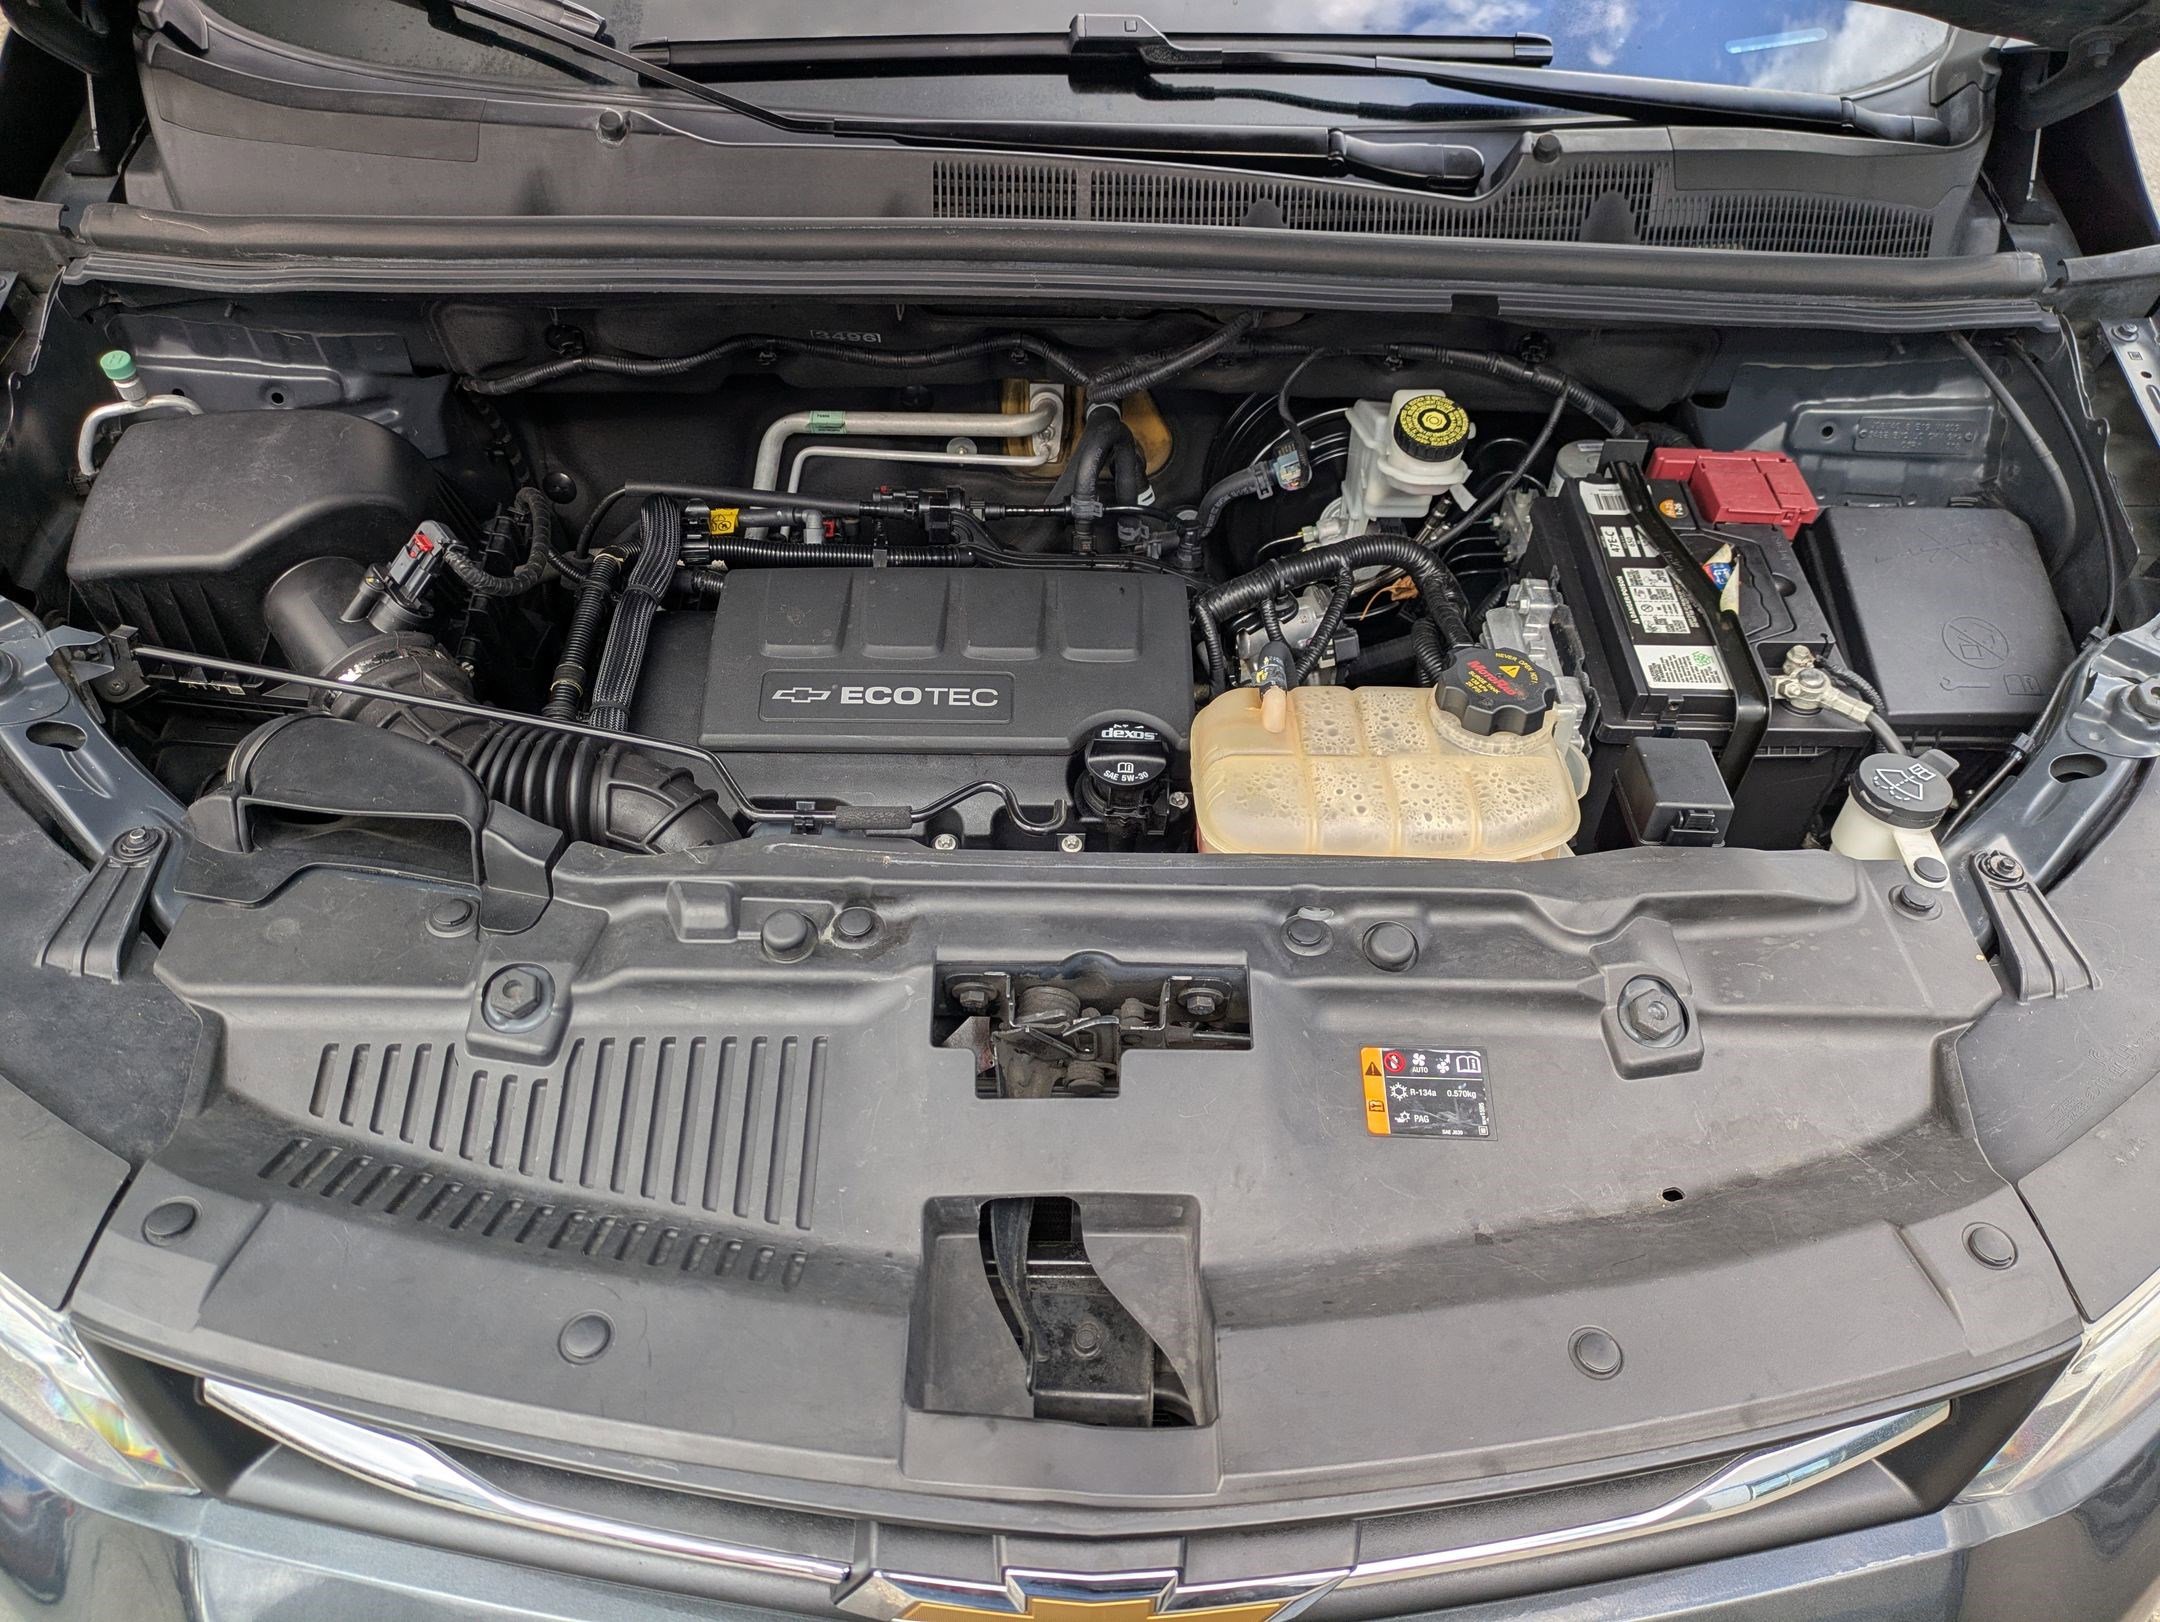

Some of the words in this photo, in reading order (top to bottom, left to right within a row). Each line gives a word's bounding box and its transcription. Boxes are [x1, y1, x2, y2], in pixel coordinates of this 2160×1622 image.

[1495, 652, 1518, 662] NEVER
[840, 686, 999, 707] ECOTEC
[1101, 727, 1156, 740] dexos
[1103, 770, 1119, 781] SAE
[1121, 771, 1149, 782] 5W-30
[1410, 1088, 1437, 1097] R-134a
[1447, 1089, 1477, 1099] 0.570kg
[1414, 1115, 1429, 1123] PAG
